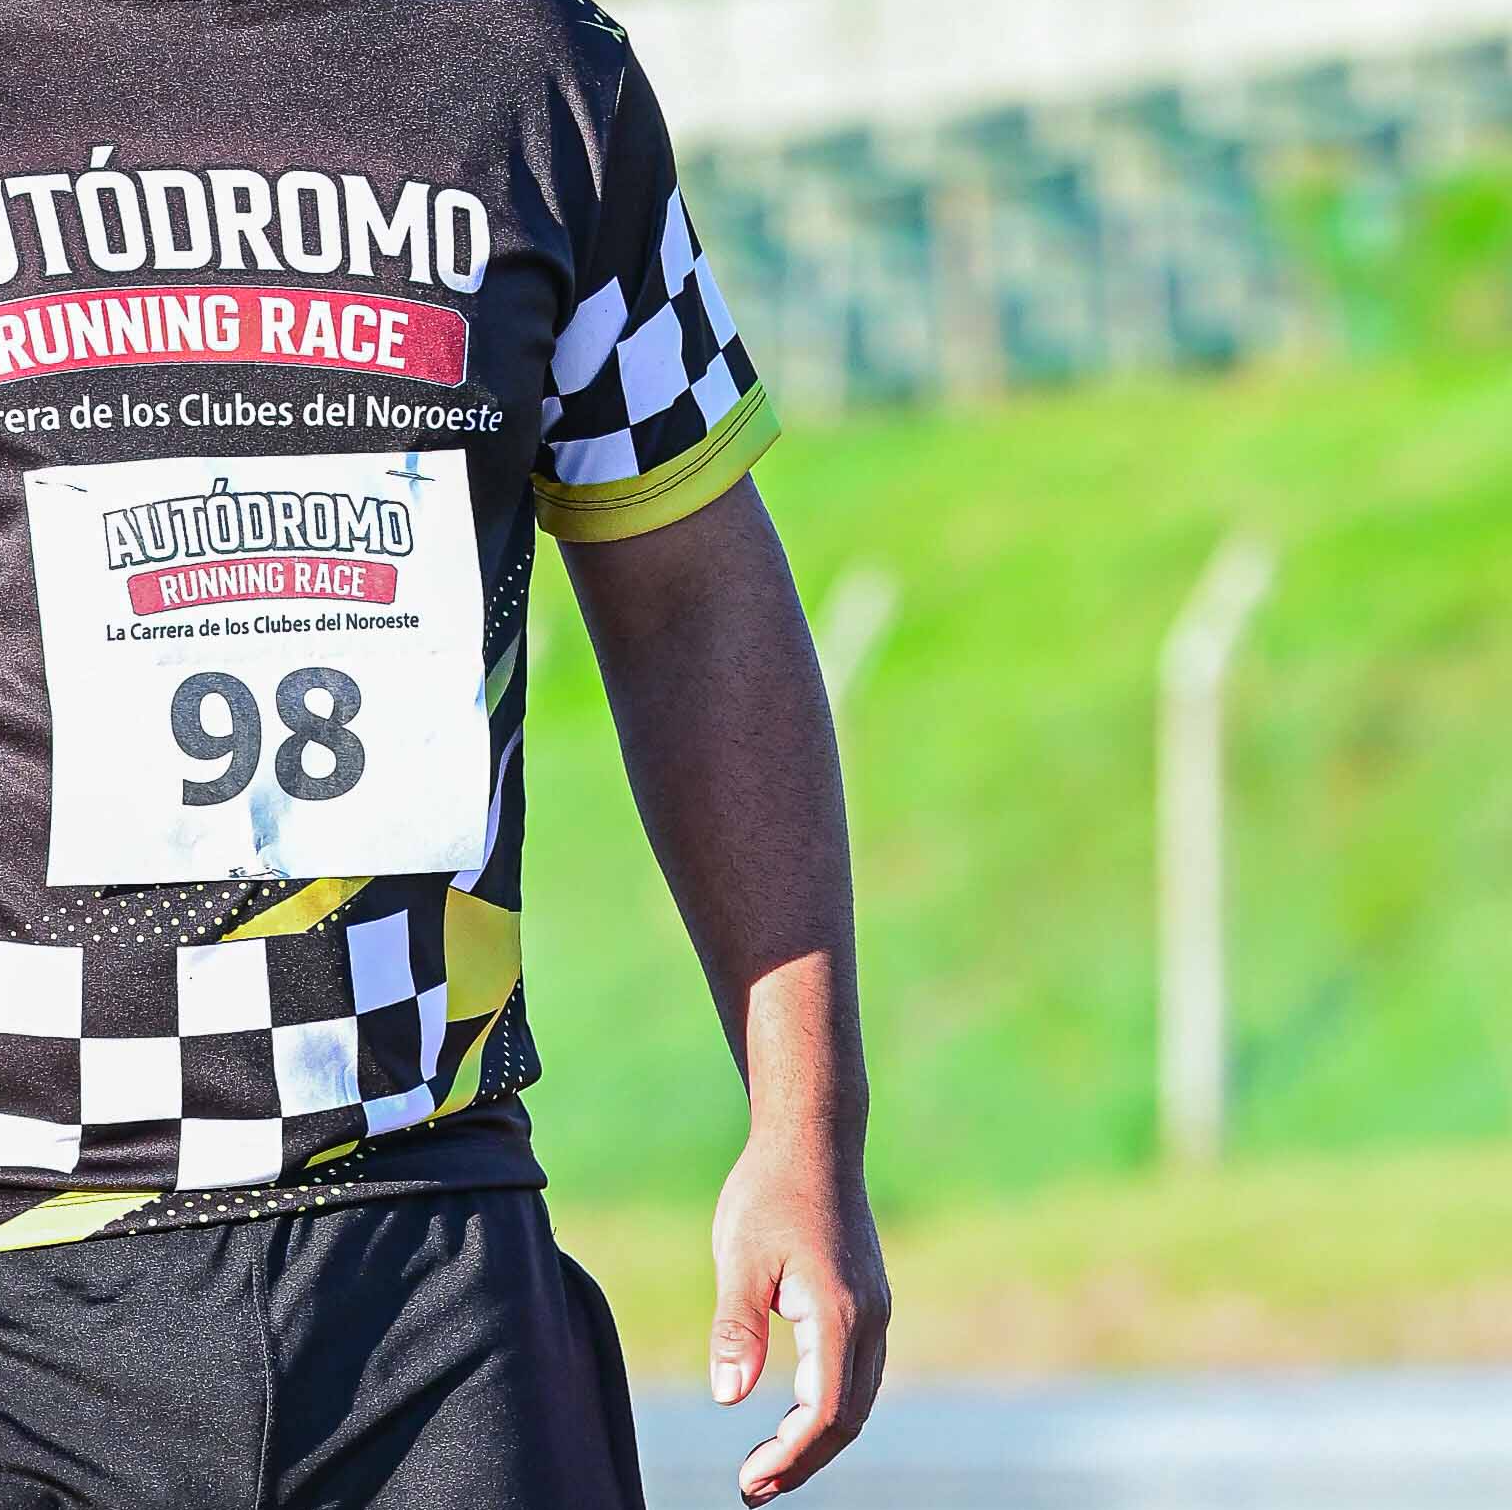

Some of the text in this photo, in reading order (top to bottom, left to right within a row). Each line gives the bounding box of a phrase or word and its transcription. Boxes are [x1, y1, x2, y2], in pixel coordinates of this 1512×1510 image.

[260, 295, 409, 370] RACE
[69, 394, 113, 430] de
[121, 393, 170, 428] los
[178, 393, 294, 428] Clubes
[302, 393, 355, 428] del
[365, 395, 504, 432] Noroeste
[102, 477, 414, 570] AUTÓDROMO
[158, 562, 366, 607] RUNNING RACE
[106, 612, 419, 641] La Carrera de los Clubes del Noroeste
[170, 666, 366, 807] 98
